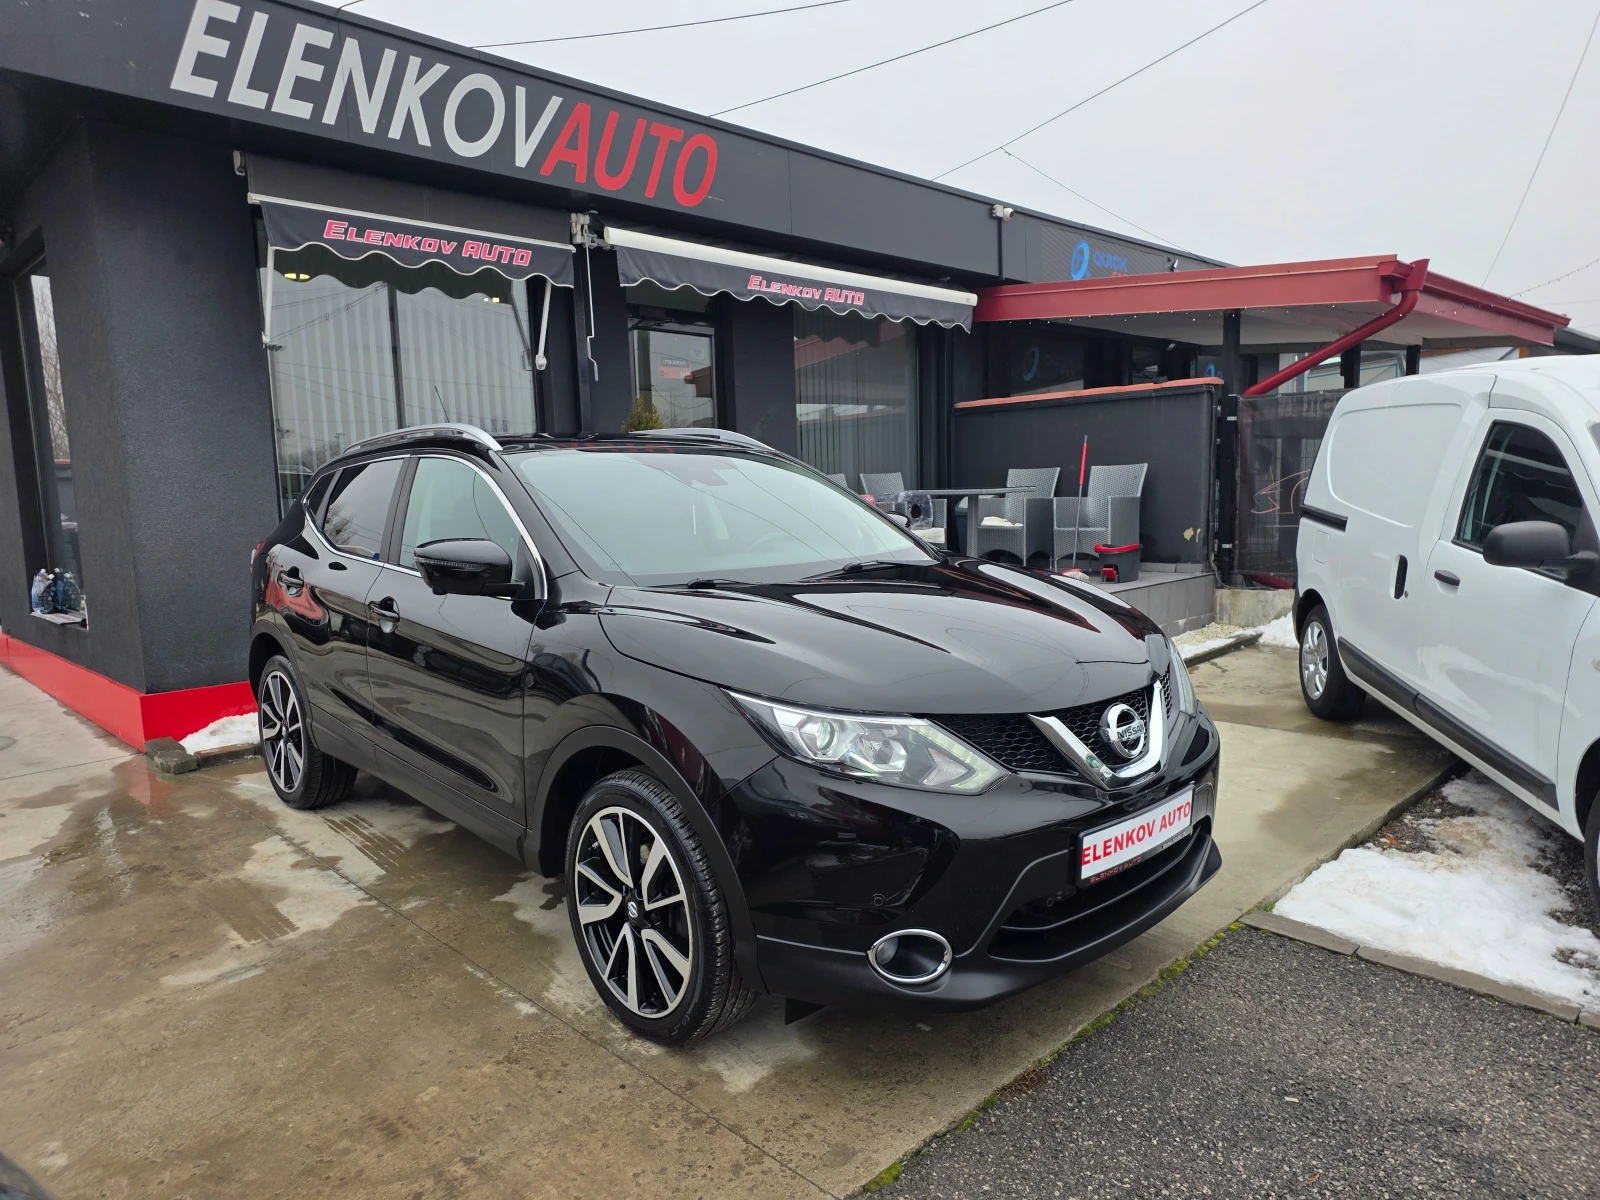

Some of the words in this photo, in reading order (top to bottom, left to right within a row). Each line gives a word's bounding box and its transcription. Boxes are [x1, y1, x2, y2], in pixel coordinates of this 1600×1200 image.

[323, 219, 457, 254] ELENKOV
[461, 240, 532, 266] AUTO
[1093, 250, 1128, 272] QUICK
[747, 275, 822, 300] ELENKOV
[824, 287, 865, 306] AUTO
[1081, 819, 1156, 866] ELENKOV
[1159, 801, 1191, 833] AUTO
[1123, 857, 1142, 869] AUTO
